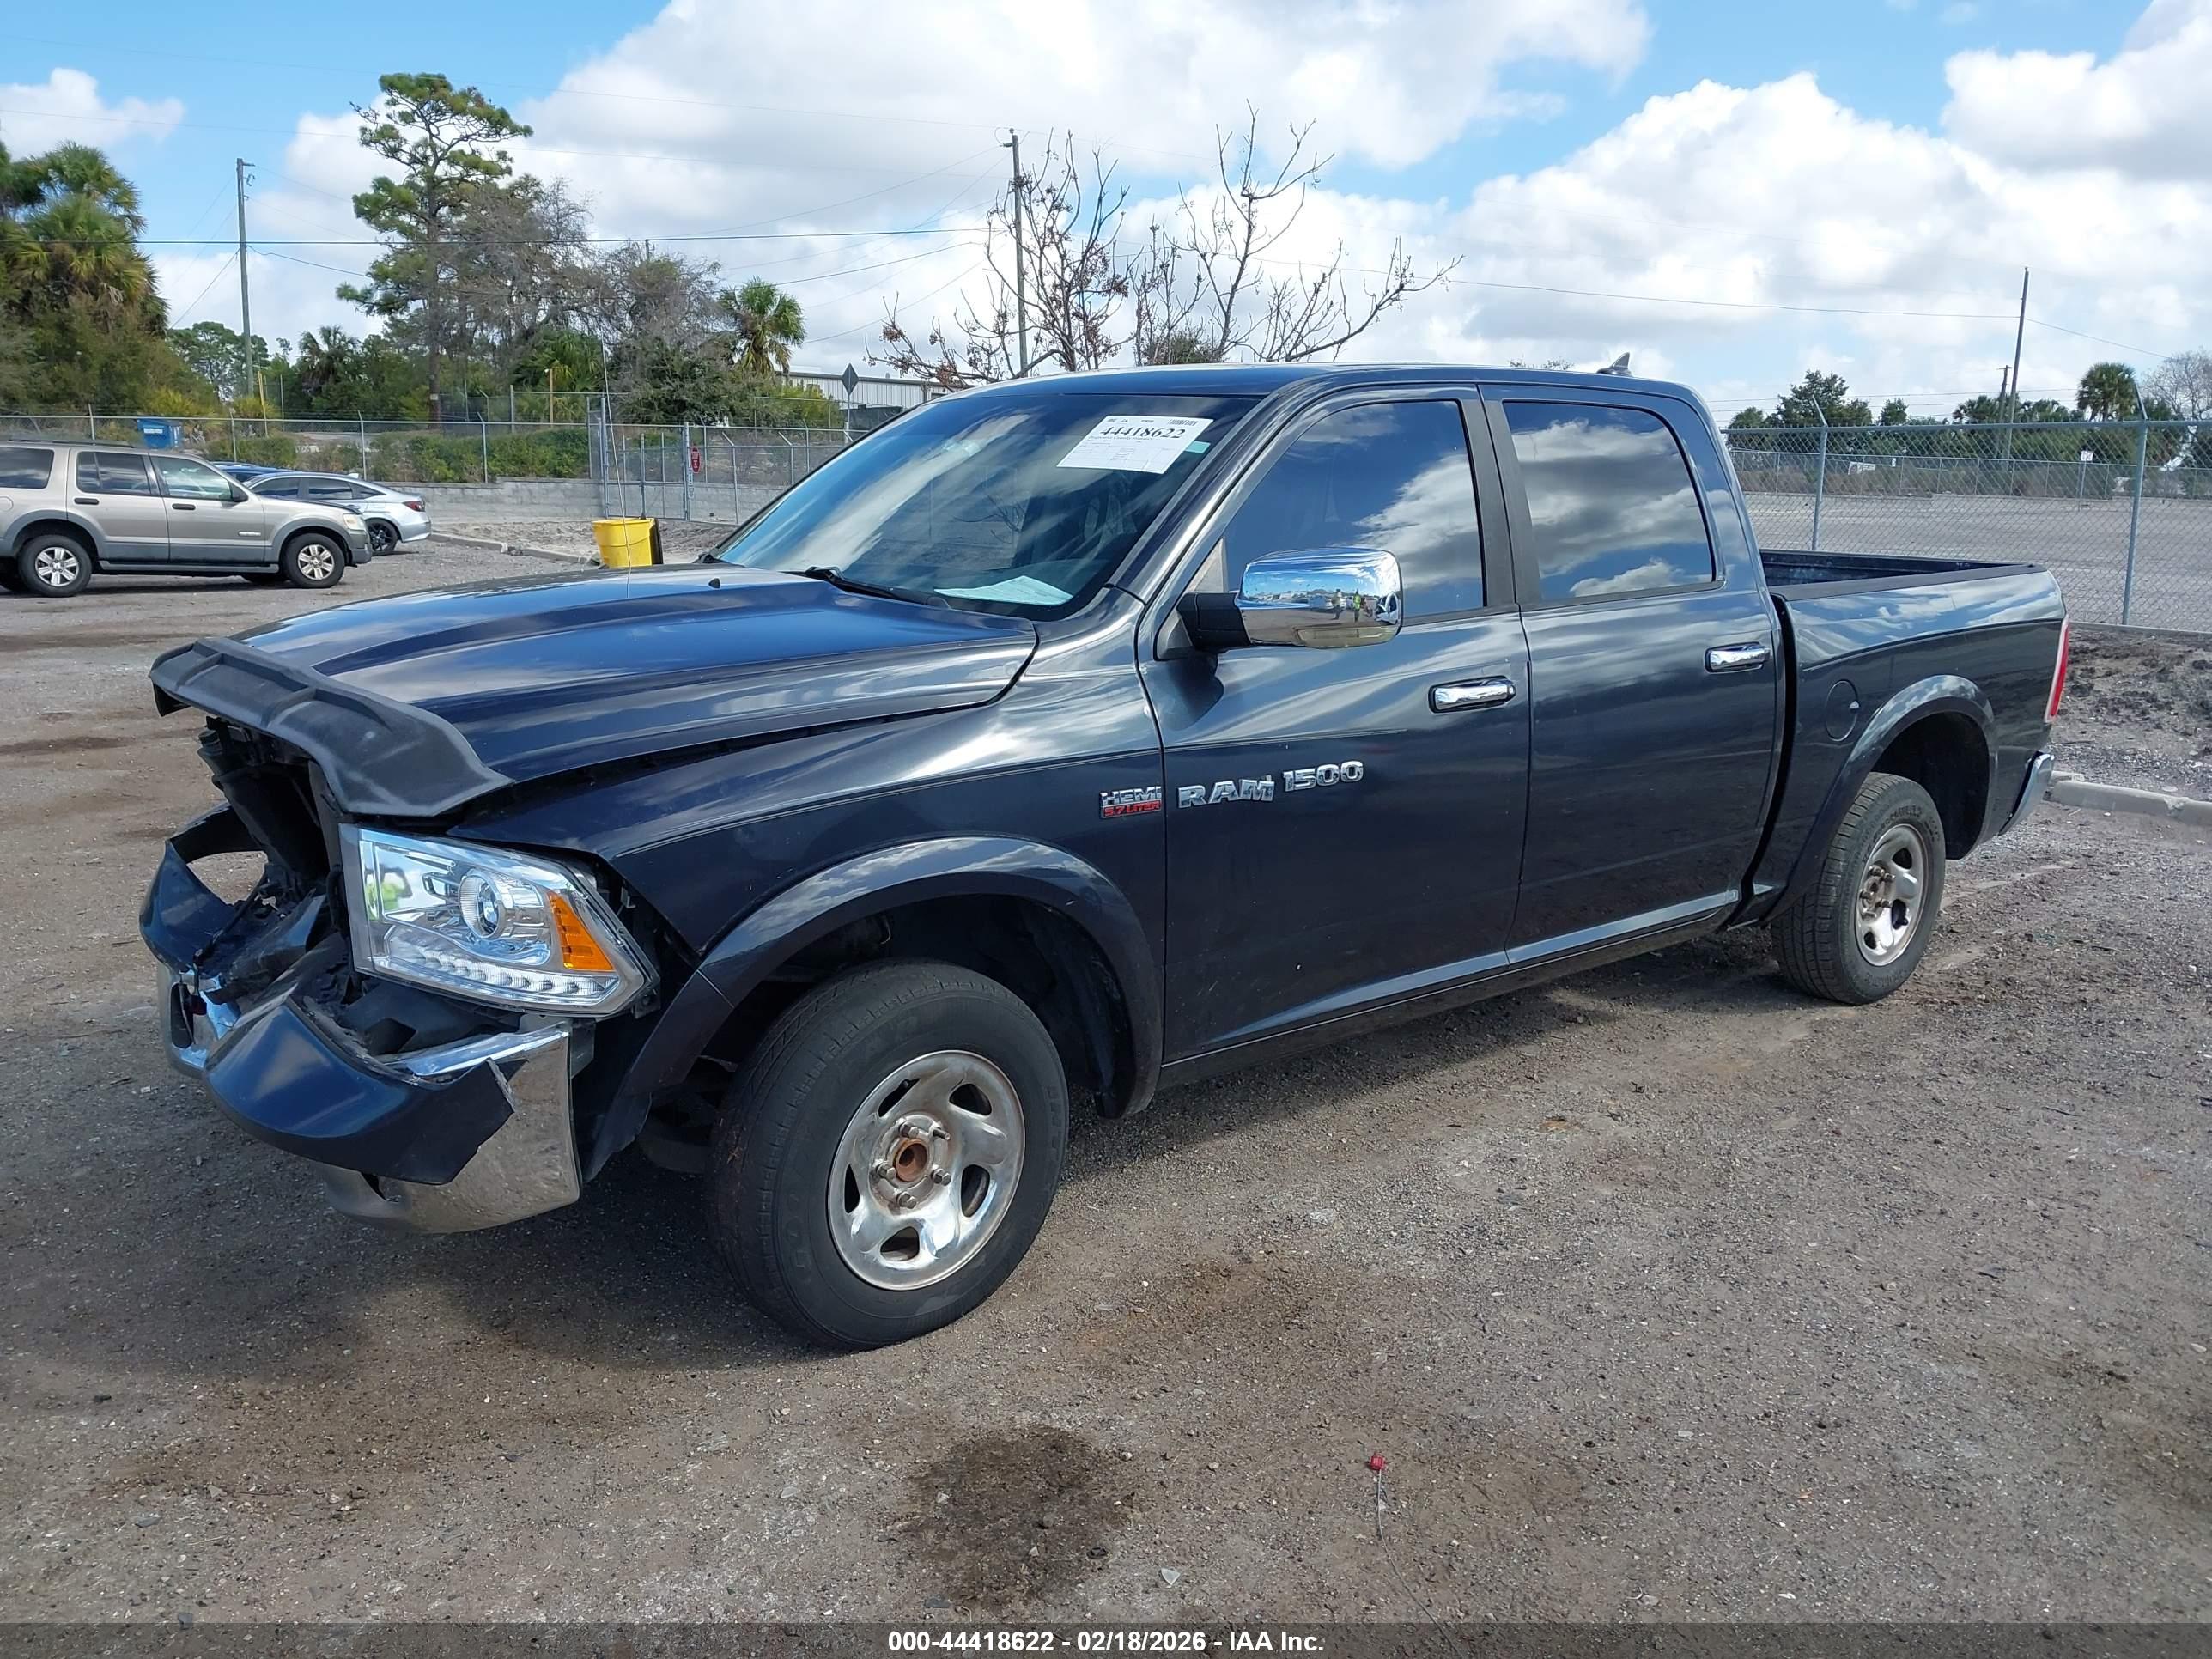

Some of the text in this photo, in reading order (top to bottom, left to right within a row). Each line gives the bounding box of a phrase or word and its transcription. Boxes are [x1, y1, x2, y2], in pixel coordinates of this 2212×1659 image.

[1099, 425, 1186, 439] 44418622
[1178, 761, 1364, 809] RAM 1500
[1100, 786, 1162, 805] HEMI
